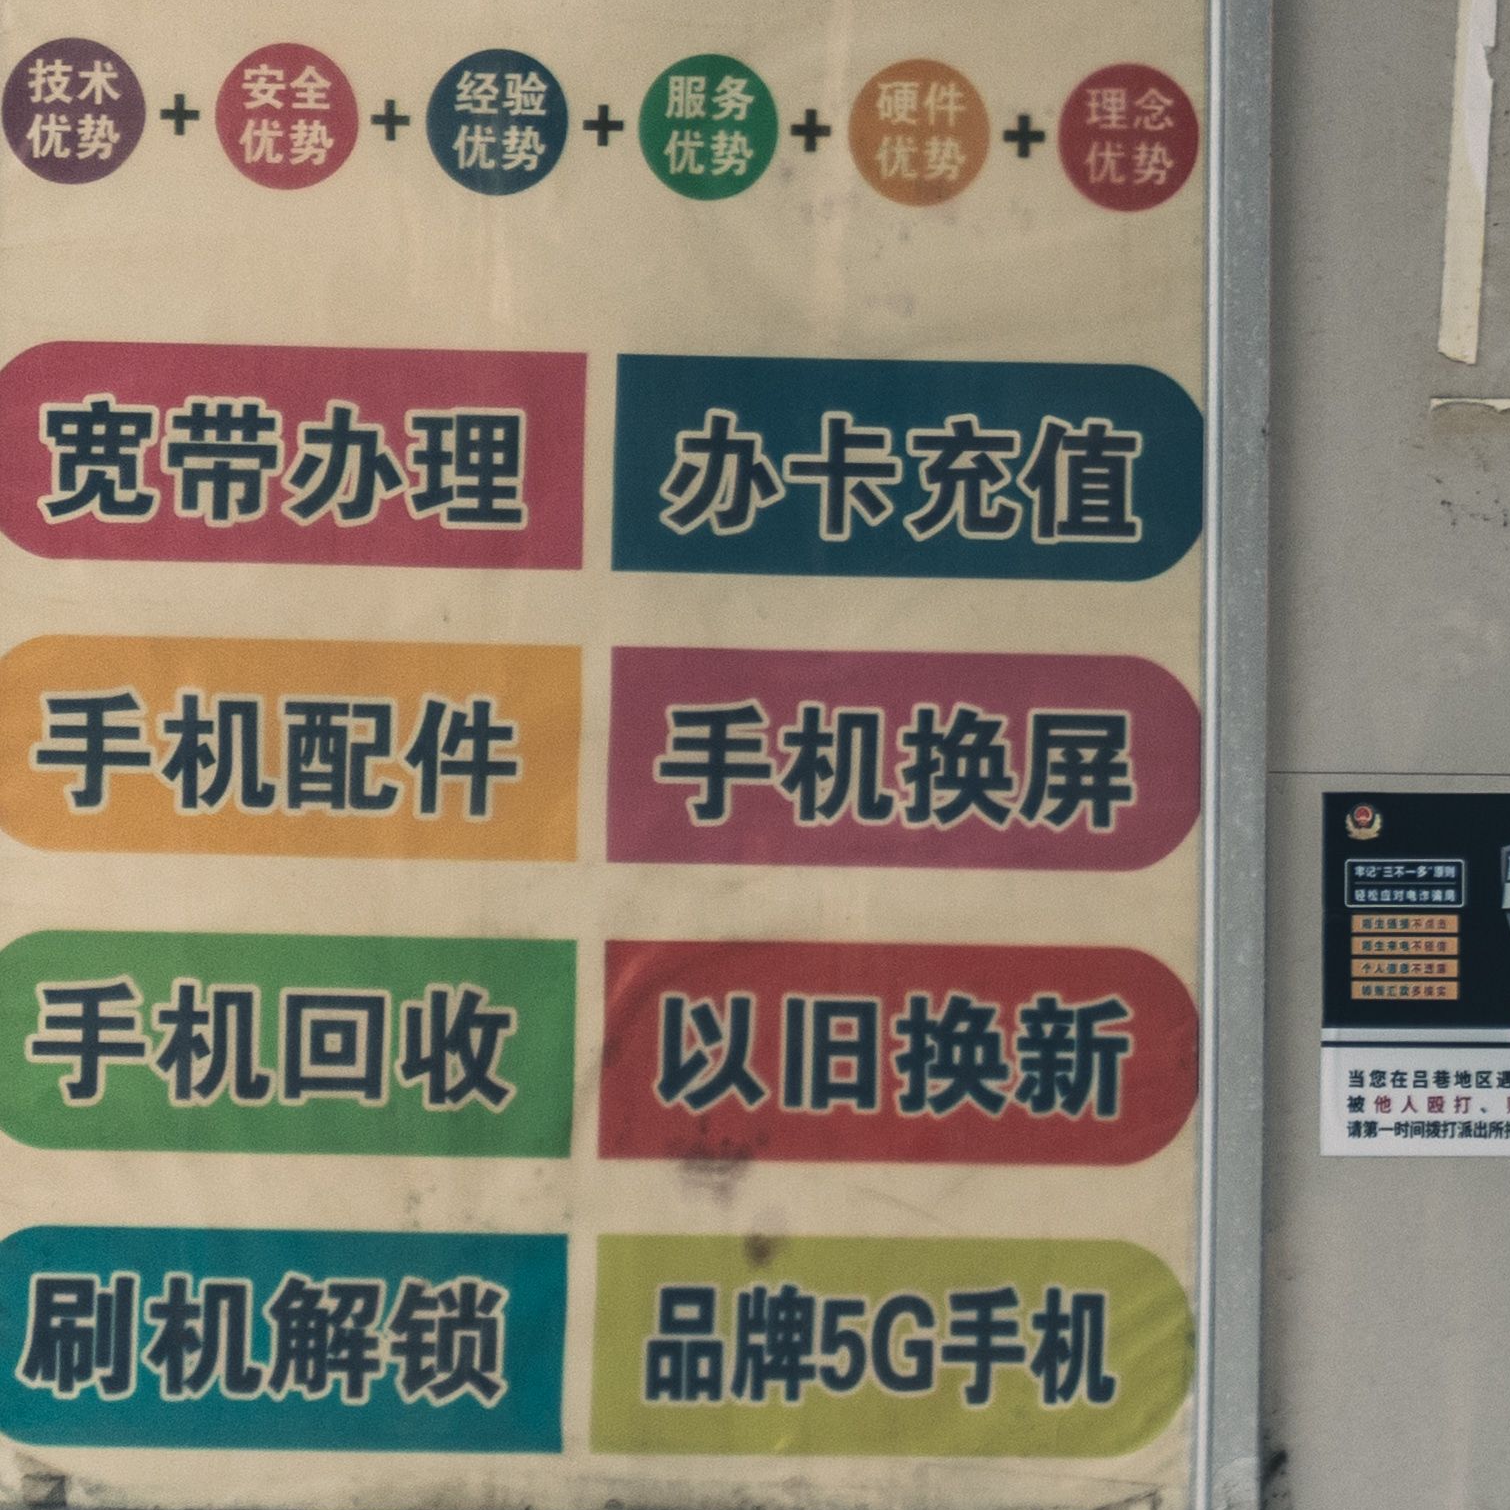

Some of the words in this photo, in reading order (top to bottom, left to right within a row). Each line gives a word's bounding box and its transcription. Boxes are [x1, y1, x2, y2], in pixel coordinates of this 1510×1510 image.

[27, 60, 120, 105] 技术
[241, 65, 333, 111] 安全
[454, 71, 547, 117] 经验
[665, 75, 755, 123] 服务
[876, 80, 965, 127] 硬件
[1087, 87, 1175, 133] 理念
[25, 113, 120, 161] 优势
[239, 119, 333, 167] 优势
[452, 124, 545, 172] 优势
[663, 129, 754, 177] 优势
[874, 133, 966, 182] 优势
[1086, 140, 1174, 187] 优势
[38, 394, 529, 532] 宽带办理
[659, 408, 1146, 546] 办卡充值
[32, 689, 524, 820] 手机配件
[654, 701, 1137, 833] 手机换屏
[27, 978, 517, 1112] 手机回收
[654, 988, 1134, 1122] 以旧换新
[14, 1267, 509, 1409] 刷机解锁
[641, 1283, 1118, 1409] 品牌5G手机
